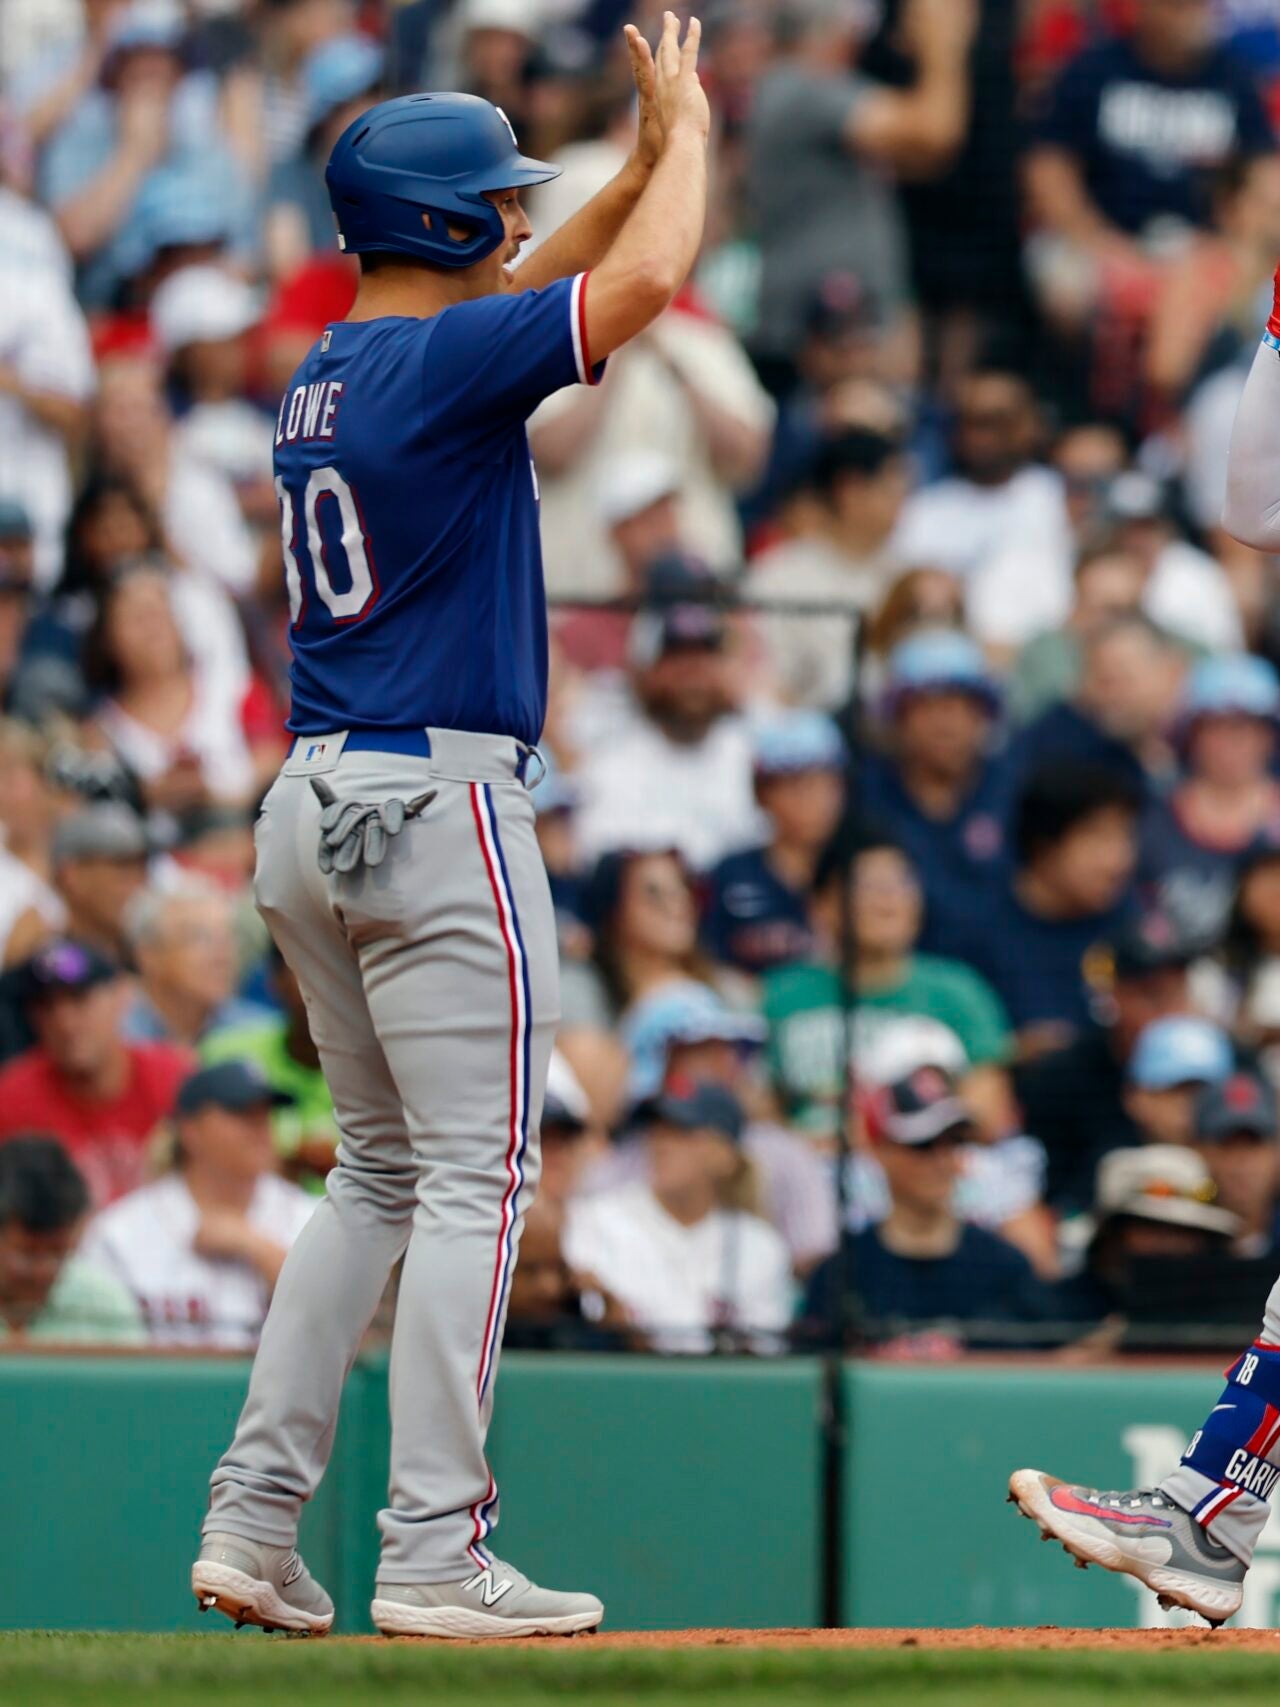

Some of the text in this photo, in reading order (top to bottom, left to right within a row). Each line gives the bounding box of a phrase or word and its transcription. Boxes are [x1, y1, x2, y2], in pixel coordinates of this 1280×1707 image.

[275, 381, 345, 448] LOWE
[1235, 1352, 1260, 1387] 18
[460, 1568, 515, 1608] N
